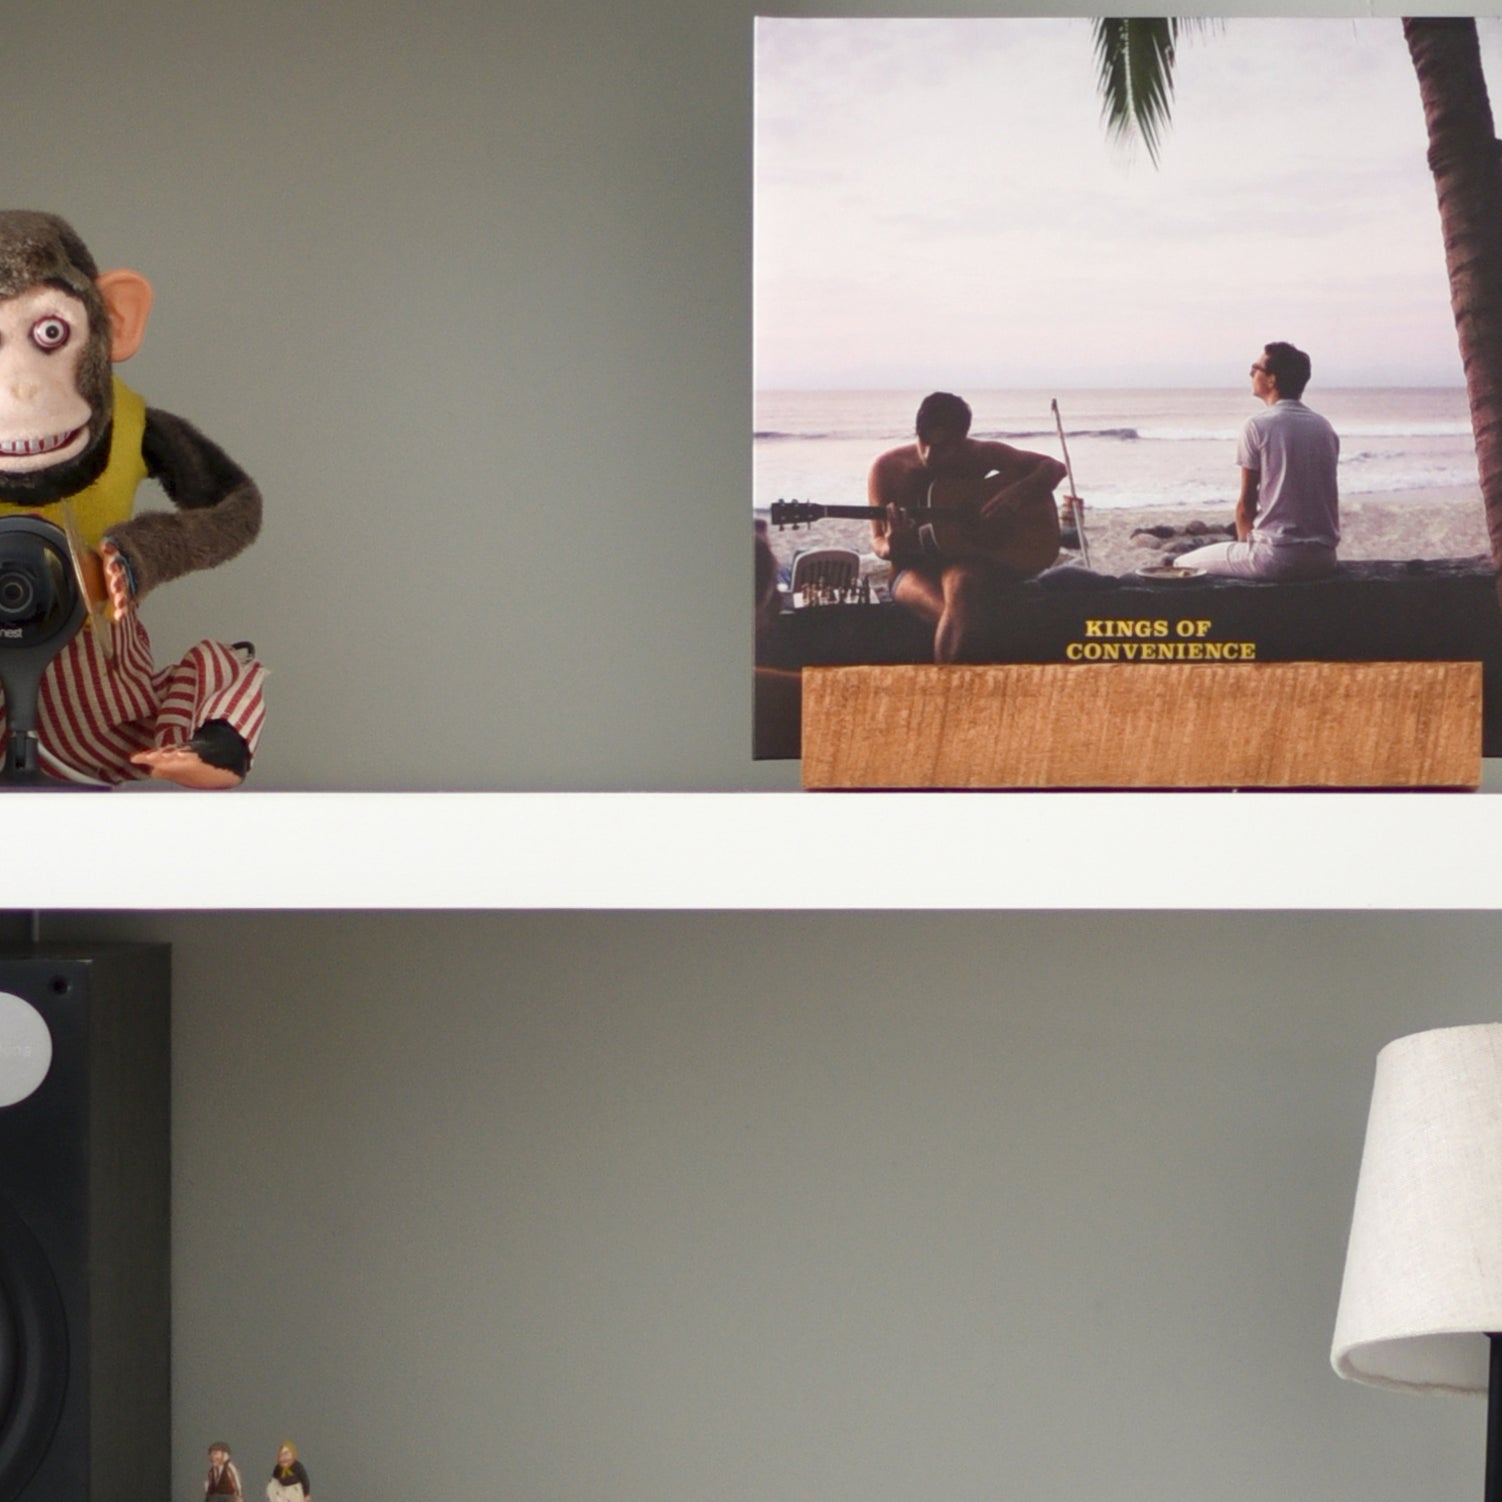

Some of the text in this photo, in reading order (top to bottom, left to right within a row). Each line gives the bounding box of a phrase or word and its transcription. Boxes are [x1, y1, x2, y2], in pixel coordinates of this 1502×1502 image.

[1085, 619, 1212, 638] KINGS OF
[1066, 642, 1257, 661] CONVENIENCE
